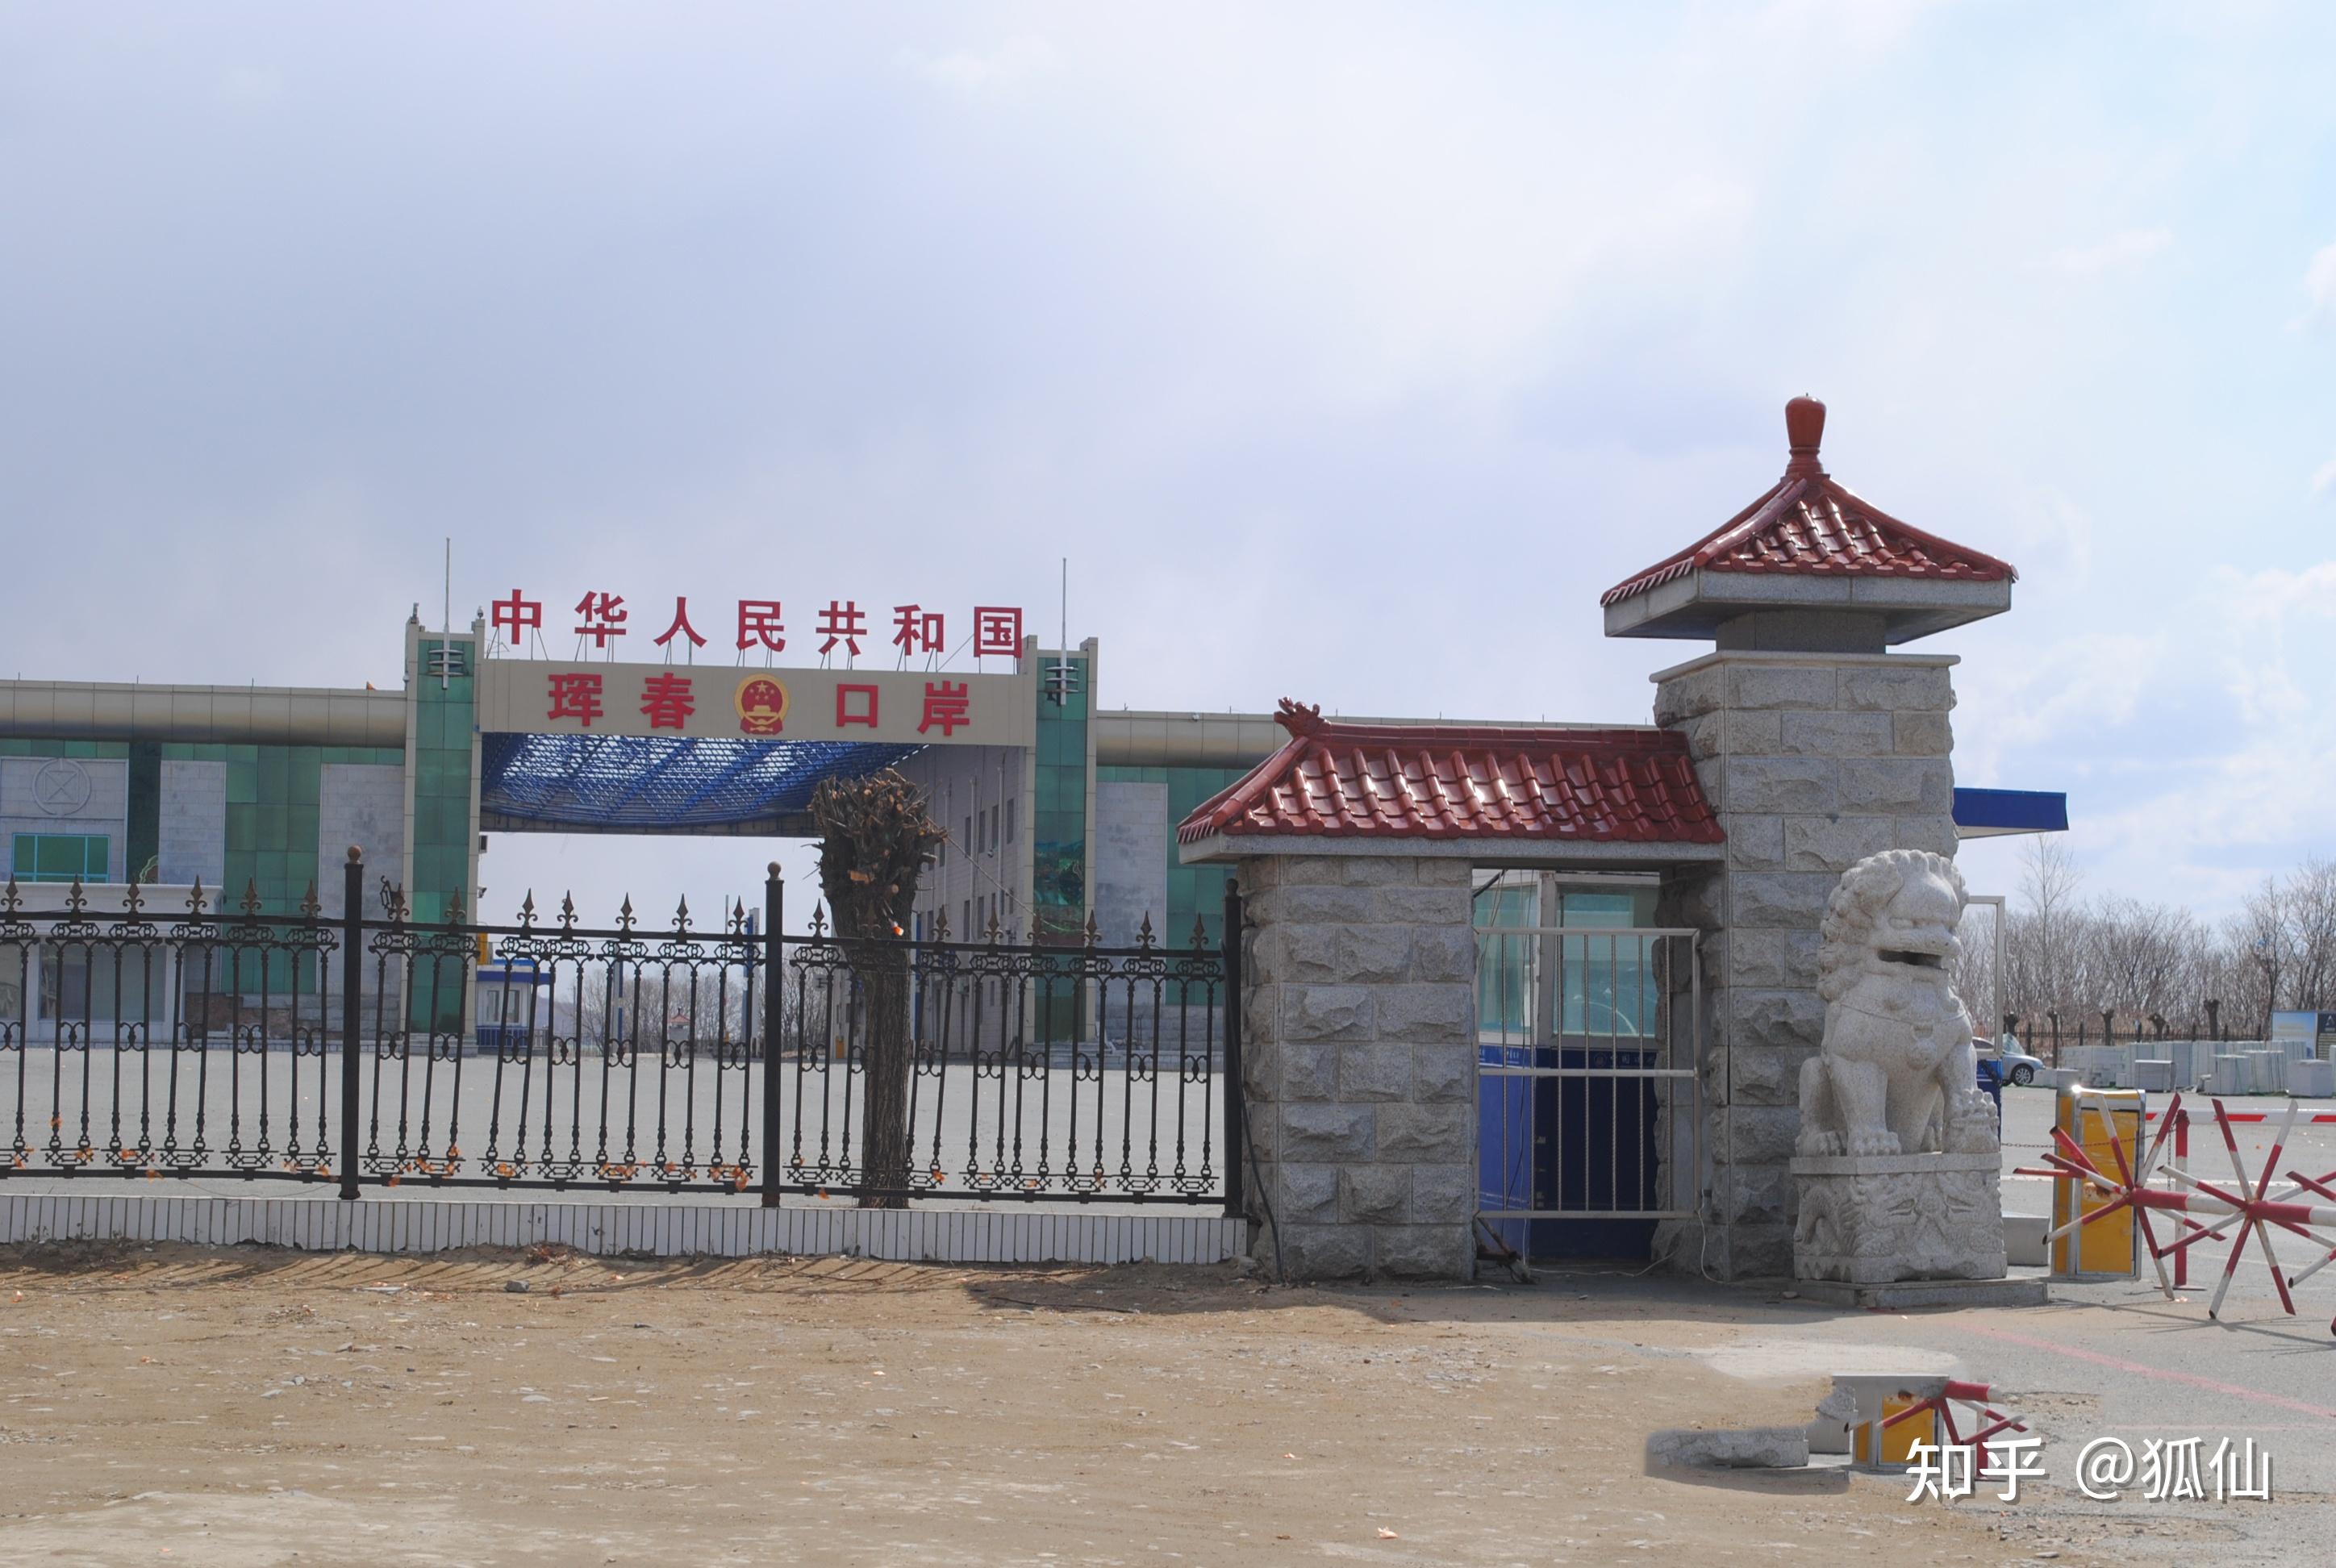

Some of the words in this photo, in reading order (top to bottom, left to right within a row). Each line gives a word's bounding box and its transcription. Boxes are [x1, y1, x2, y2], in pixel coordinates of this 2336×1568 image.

[492, 589, 1023, 659] 中华人民共和国
[548, 672, 695, 729] 珲春
[836, 680, 970, 736] 口岸
